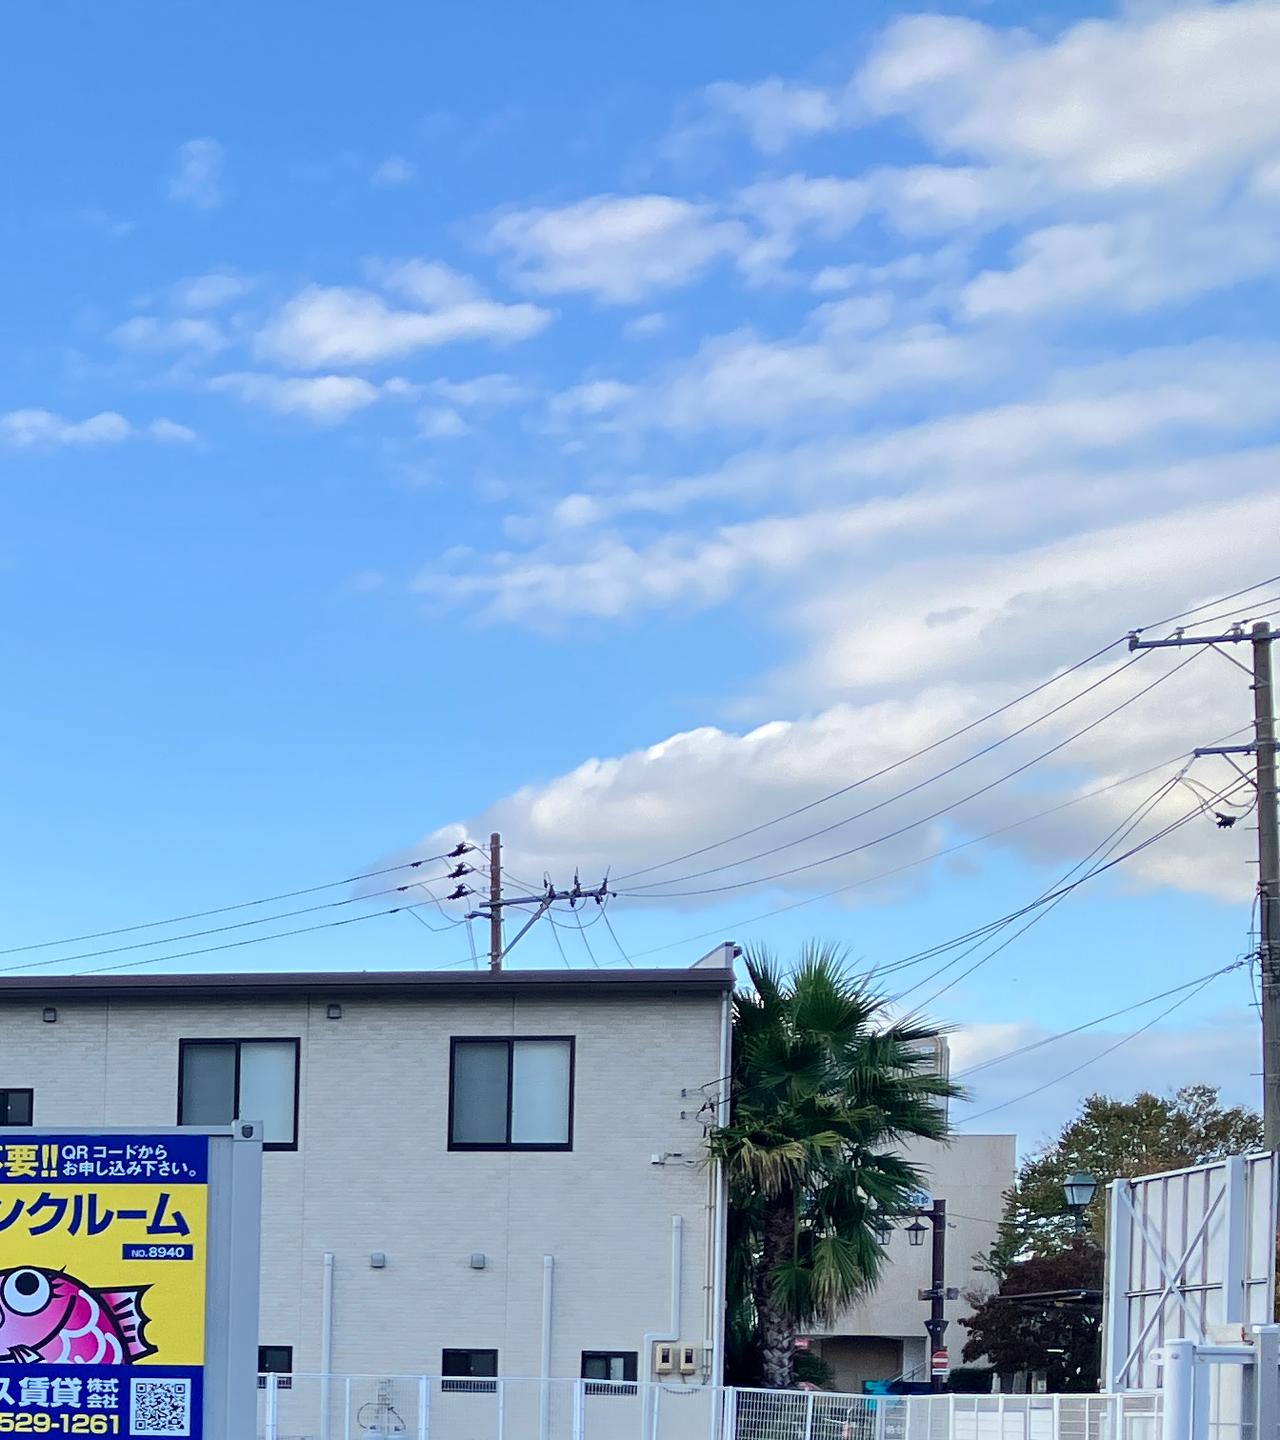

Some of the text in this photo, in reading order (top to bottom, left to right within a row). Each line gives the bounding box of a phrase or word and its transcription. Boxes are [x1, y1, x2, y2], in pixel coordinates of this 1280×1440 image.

[62, 1160, 197, 1177] お申し込み下さい。
[130, 1246, 185, 1259] NO.8940
